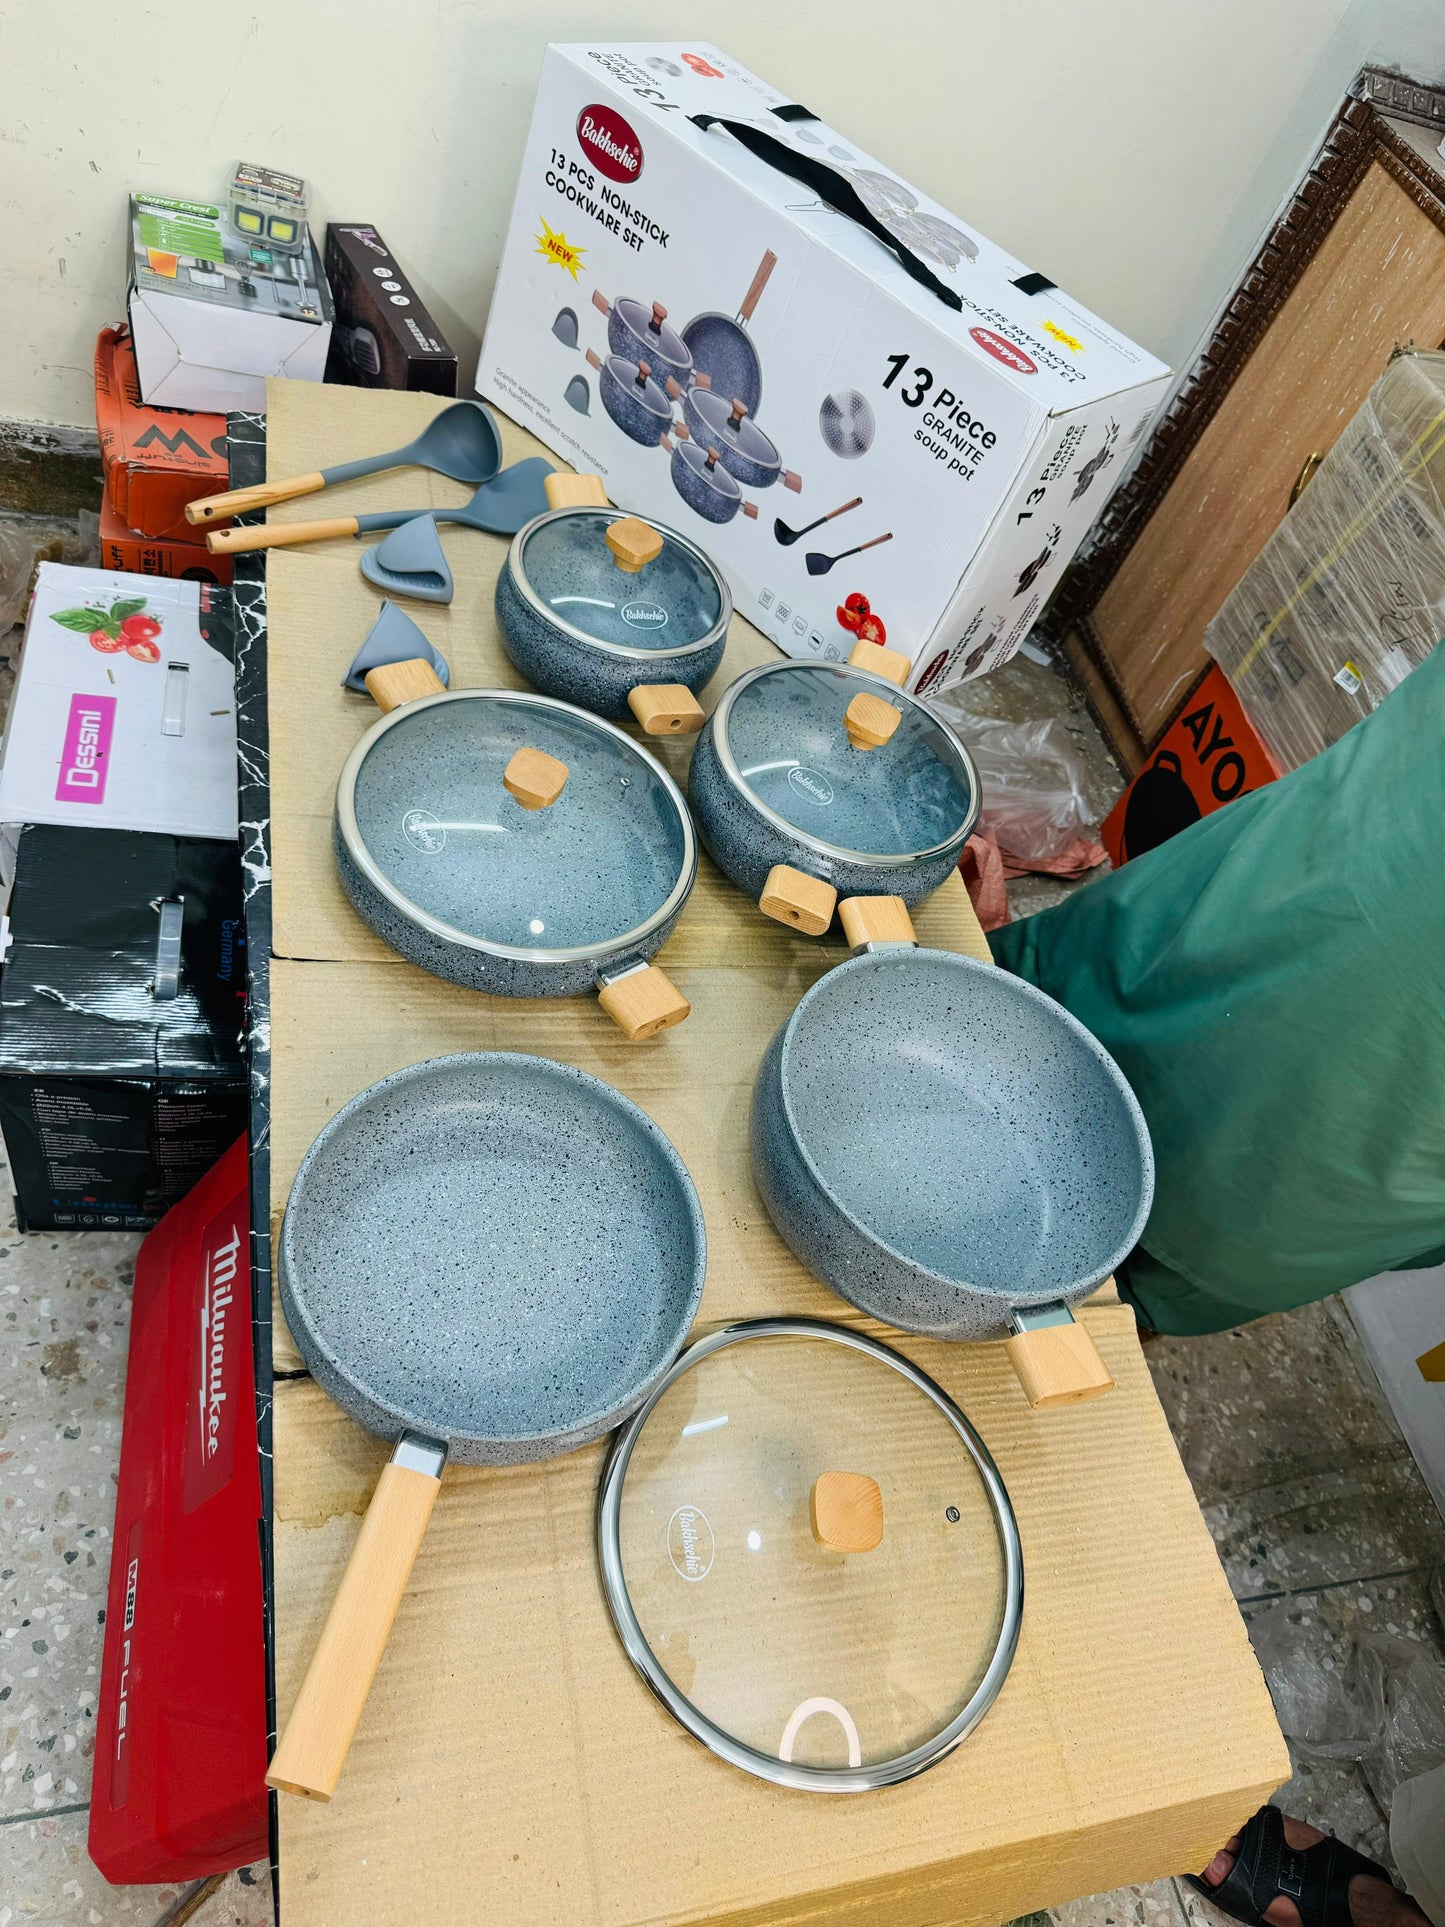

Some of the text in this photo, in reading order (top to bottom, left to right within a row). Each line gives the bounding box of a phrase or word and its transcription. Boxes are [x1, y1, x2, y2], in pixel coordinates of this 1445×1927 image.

[587, 51, 681, 112] 13 Piece
[601, 52, 651, 87] GRANITE
[581, 116, 639, 173] Bakhschie
[140, 193, 178, 207] Super
[180, 201, 211, 213] Crest
[545, 171, 644, 252] COOKWARE SET
[551, 148, 670, 249] 13 PCS NON-STICK
[547, 239, 573, 263] NEW
[985, 307, 1087, 381] COOKWARE SET
[1030, 350, 1055, 370] PCS
[1051, 326, 1076, 348] NEW
[496, 367, 551, 413] Granite appearance
[882, 353, 998, 450] 13 Piece
[1059, 372, 1076, 383] 13
[493, 378, 609, 476] High hardness, excellent scratch resistance
[914, 429, 976, 482] soup pot
[922, 412, 985, 466] GRANITE
[1017, 425, 1076, 526] 13 Piece
[65, 709, 102, 788] Dessini
[1181, 702, 1255, 802] AYO
[218, 919, 236, 982] Germany
[208, 1223, 241, 1461] Milwaukee
[117, 1561, 138, 1761] M88 FUEL
